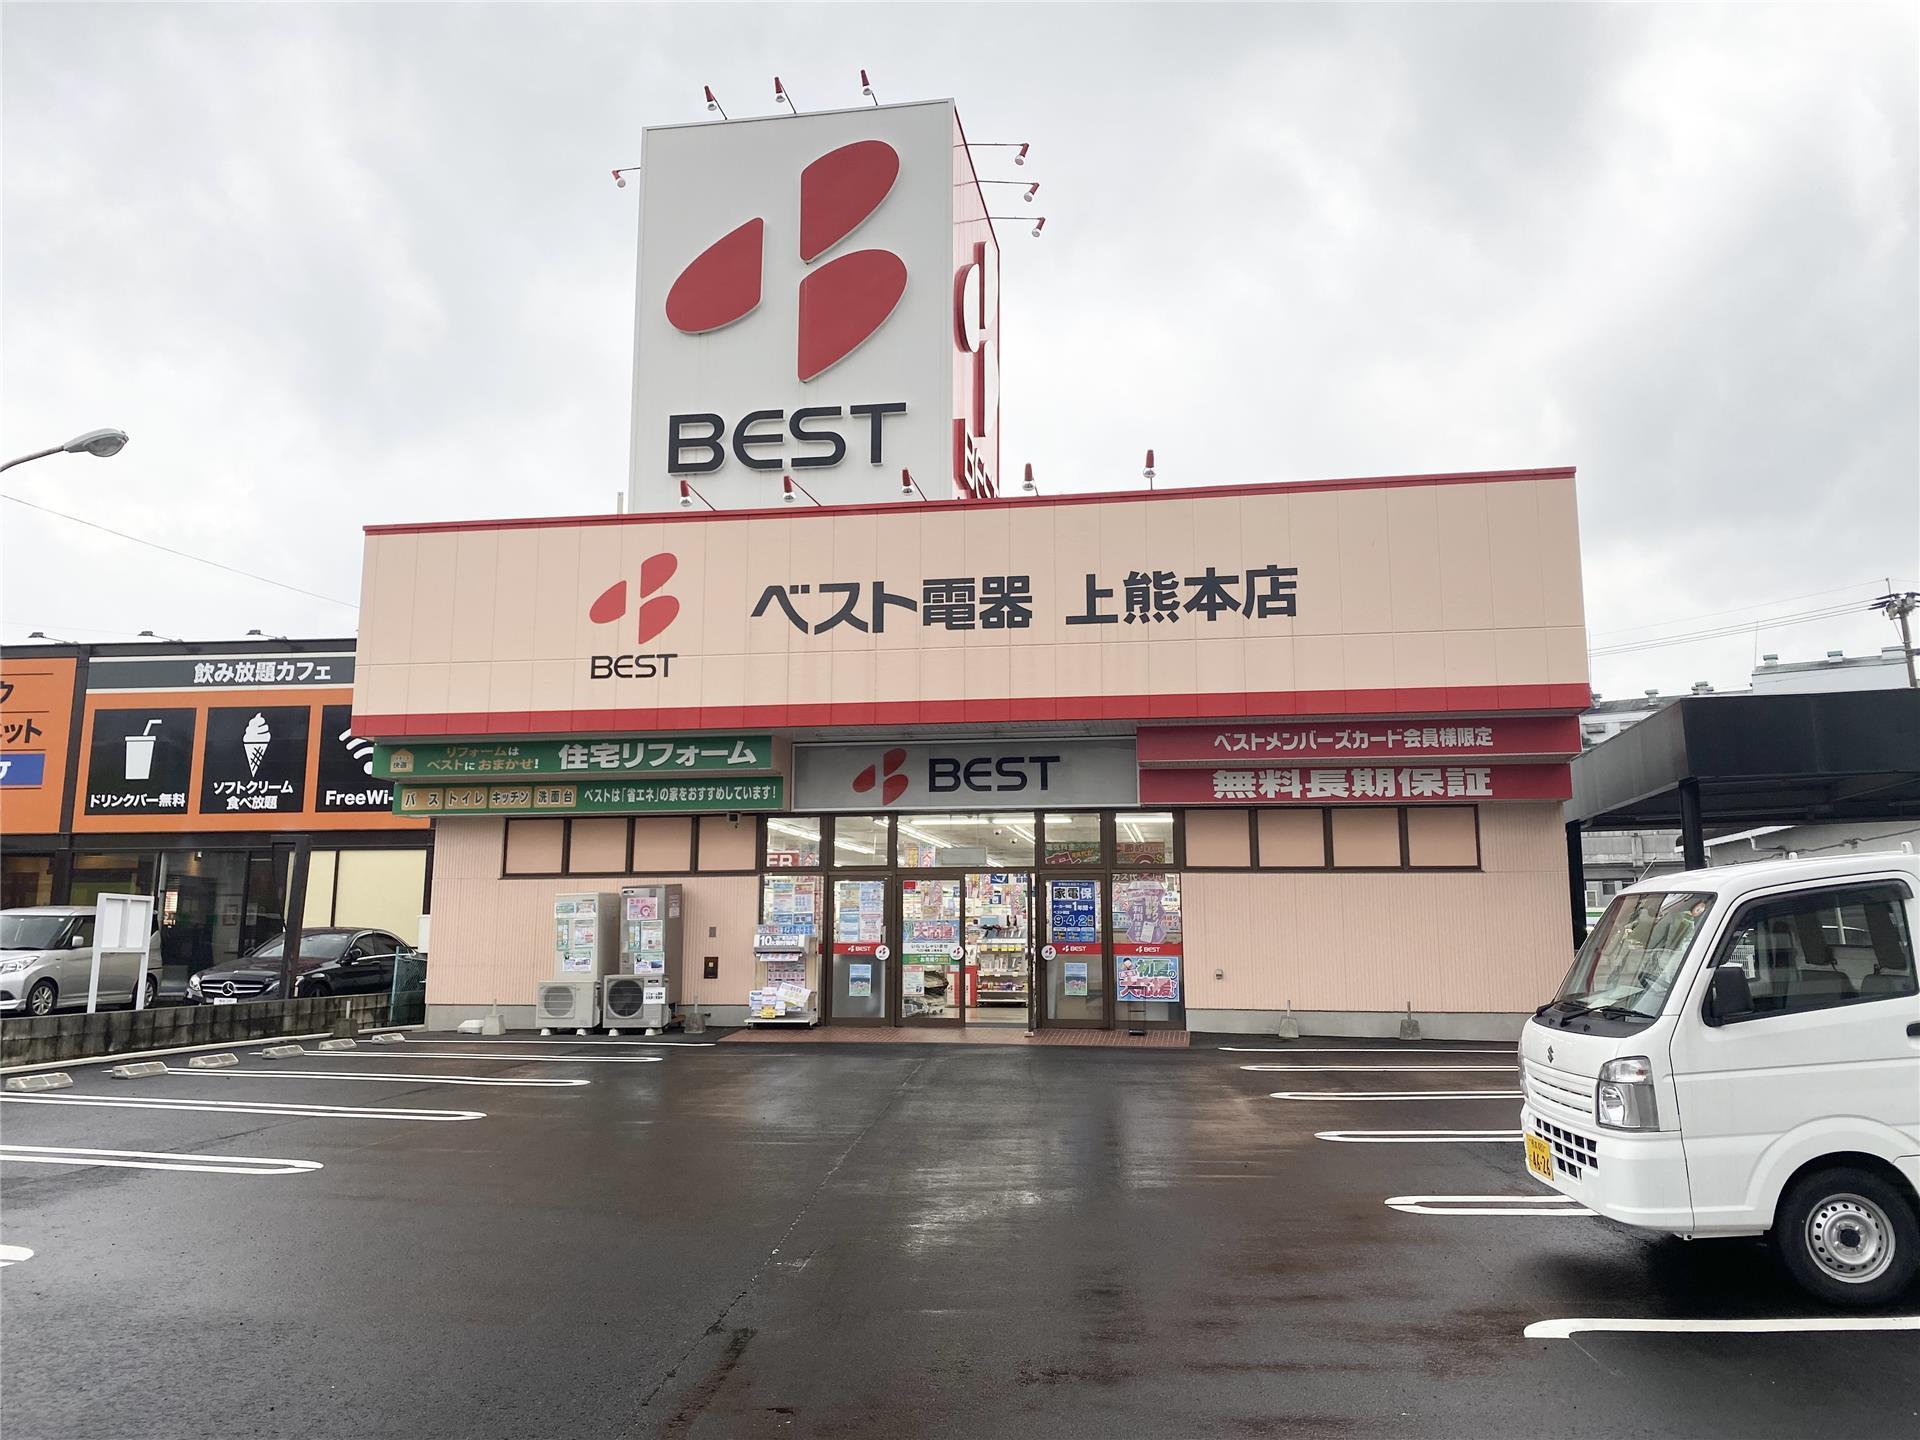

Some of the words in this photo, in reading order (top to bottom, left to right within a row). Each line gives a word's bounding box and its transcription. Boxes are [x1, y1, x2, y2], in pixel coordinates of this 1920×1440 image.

[667, 402, 907, 475] BEST
[751, 575, 1033, 635] ベスト電器
[1065, 565, 1298, 624] 上熊本店
[194, 661, 331, 684] 飲み放題カフェ
[591, 653, 678, 679] BEST
[0, 719, 42, 743] ット
[1214, 727, 1493, 751] ベストメンバーズカード会員様限定
[446, 746, 519, 758] リフォームは
[558, 741, 757, 770] 住宅リフォーム
[929, 756, 1060, 792] BEST
[1212, 768, 1493, 799] 無料長期保証
[90, 792, 185, 807] ドリンクバー無料
[213, 780, 293, 795] ソフトクリーム
[448, 791, 484, 806] トイレ
[492, 791, 529, 805] キッチン
[537, 790, 575, 804] 洗面台
[226, 795, 278, 810] 食べ放題
